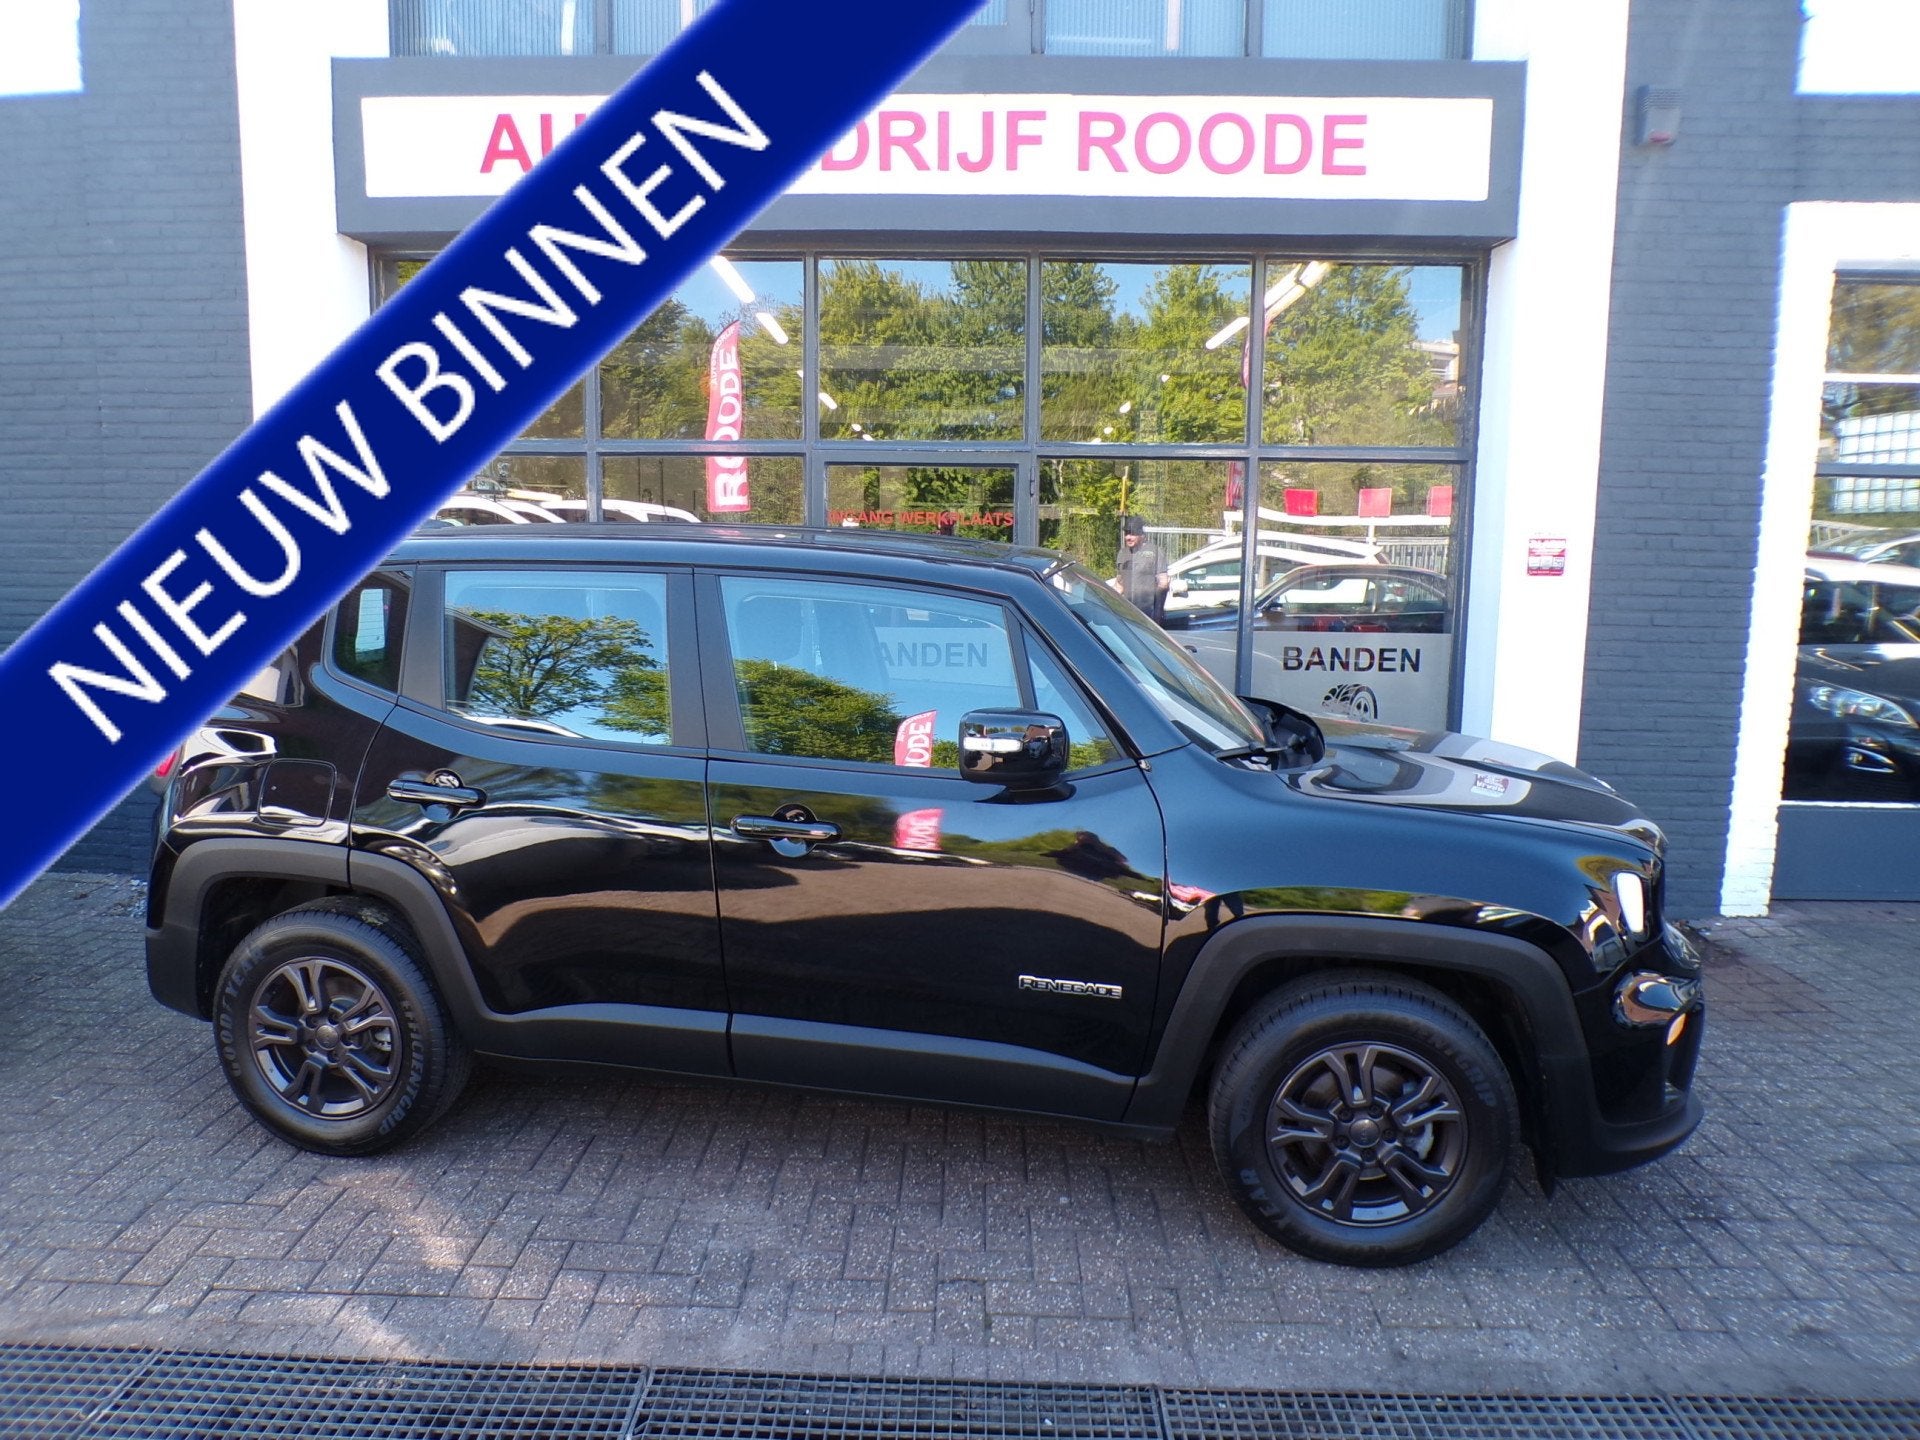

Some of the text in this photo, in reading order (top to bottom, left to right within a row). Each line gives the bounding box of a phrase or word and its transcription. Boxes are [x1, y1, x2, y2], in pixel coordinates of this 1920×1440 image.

[1078, 111, 1368, 175] ROODE
[828, 510, 1014, 526] INGANG WERKPLAATS
[879, 642, 988, 668] ANDEN
[1282, 646, 1421, 673] BANDEN
[1018, 974, 1123, 999] RENEGADE
